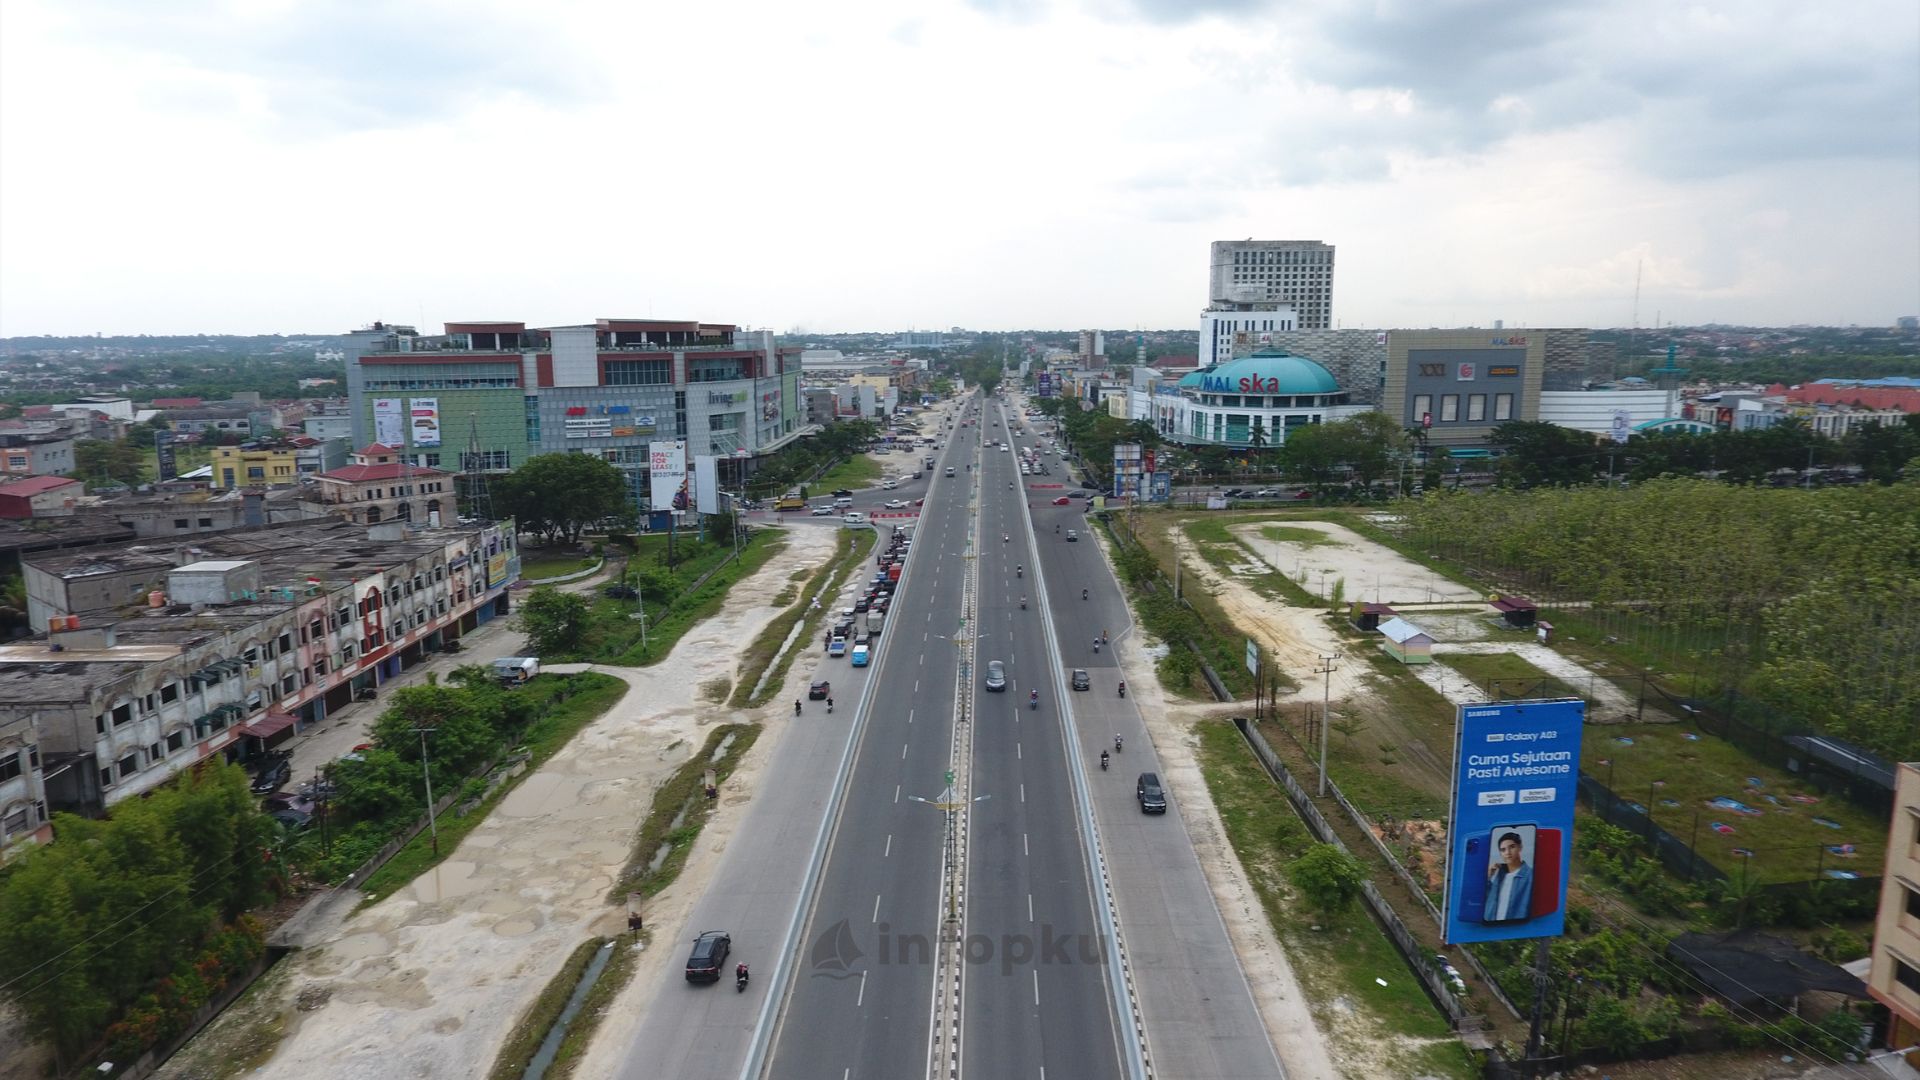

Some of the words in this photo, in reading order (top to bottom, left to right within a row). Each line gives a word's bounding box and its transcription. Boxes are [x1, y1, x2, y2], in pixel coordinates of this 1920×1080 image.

[1418, 362, 1446, 377] XXI
[1203, 375, 1232, 392] MAL
[1238, 372, 1279, 393] ska
[1505, 733, 1539, 743] Galaxy
[1539, 731, 1558, 740] A03
[1468, 754, 1509, 766] Cuma
[1511, 751, 1571, 766] Sejutaan
[1467, 766, 1501, 779] Pasti
[1503, 764, 1570, 777] Awesome
